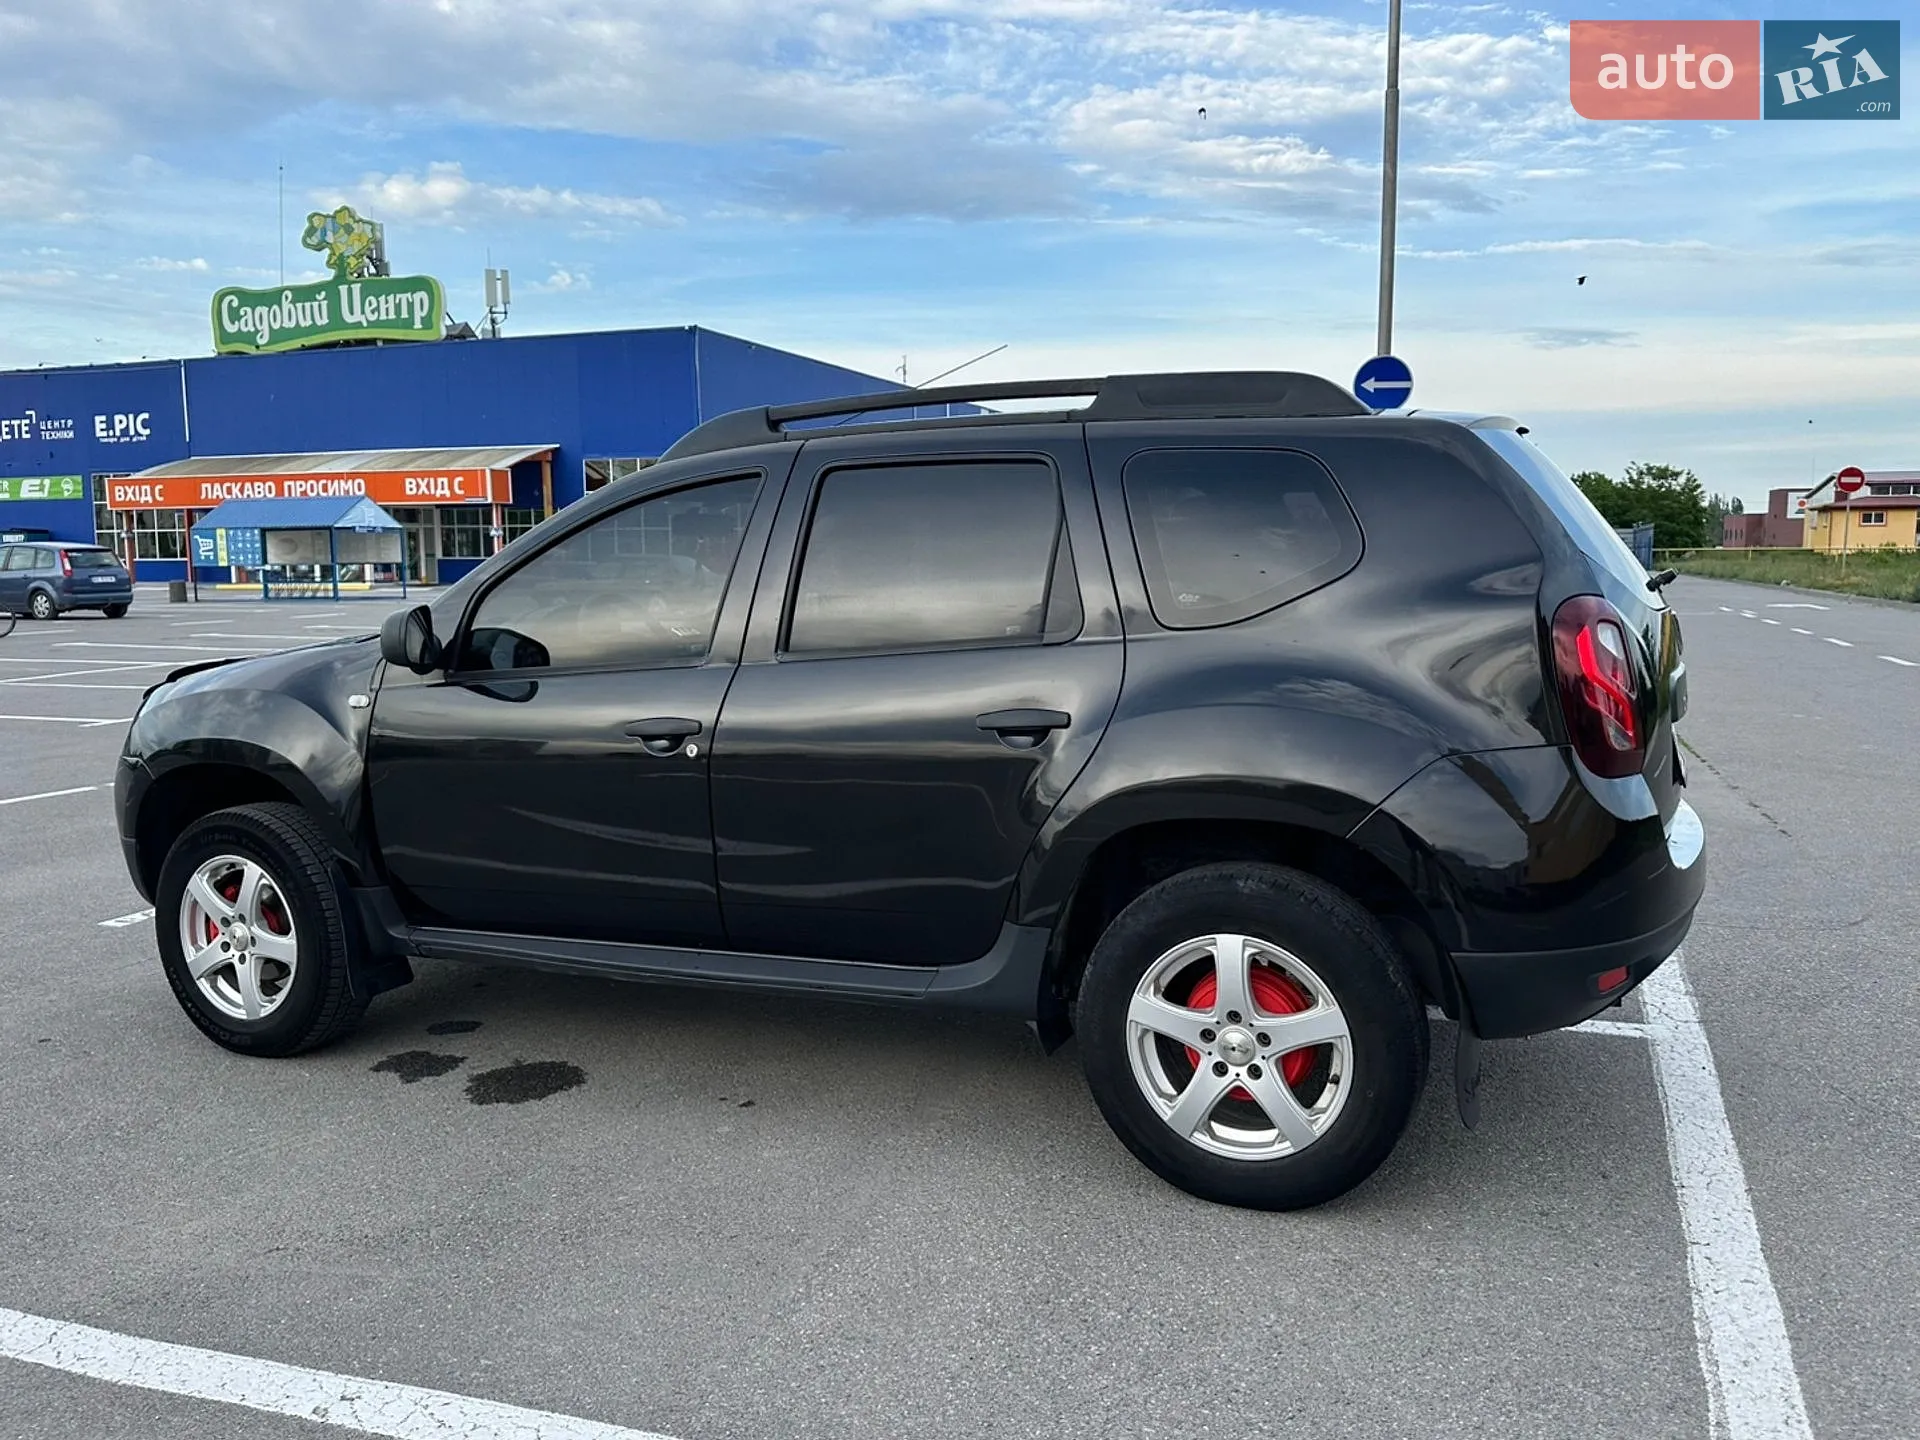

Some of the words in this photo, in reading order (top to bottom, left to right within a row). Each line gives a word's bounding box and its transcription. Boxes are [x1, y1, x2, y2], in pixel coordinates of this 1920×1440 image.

[220, 289, 330, 345] Садовий
[338, 283, 429, 329] Центр
[0, 419, 31, 442] ЕТЕ
[40, 419, 74, 431] ЦЕНТР
[94, 413, 151, 437] E.PIC
[114, 485, 153, 504] ВХІД
[155, 485, 164, 502] С
[200, 481, 276, 500] ЛАСКАВО
[283, 478, 366, 498] ПРОСИМО
[405, 476, 450, 498] ВХІД
[452, 476, 464, 495] С
